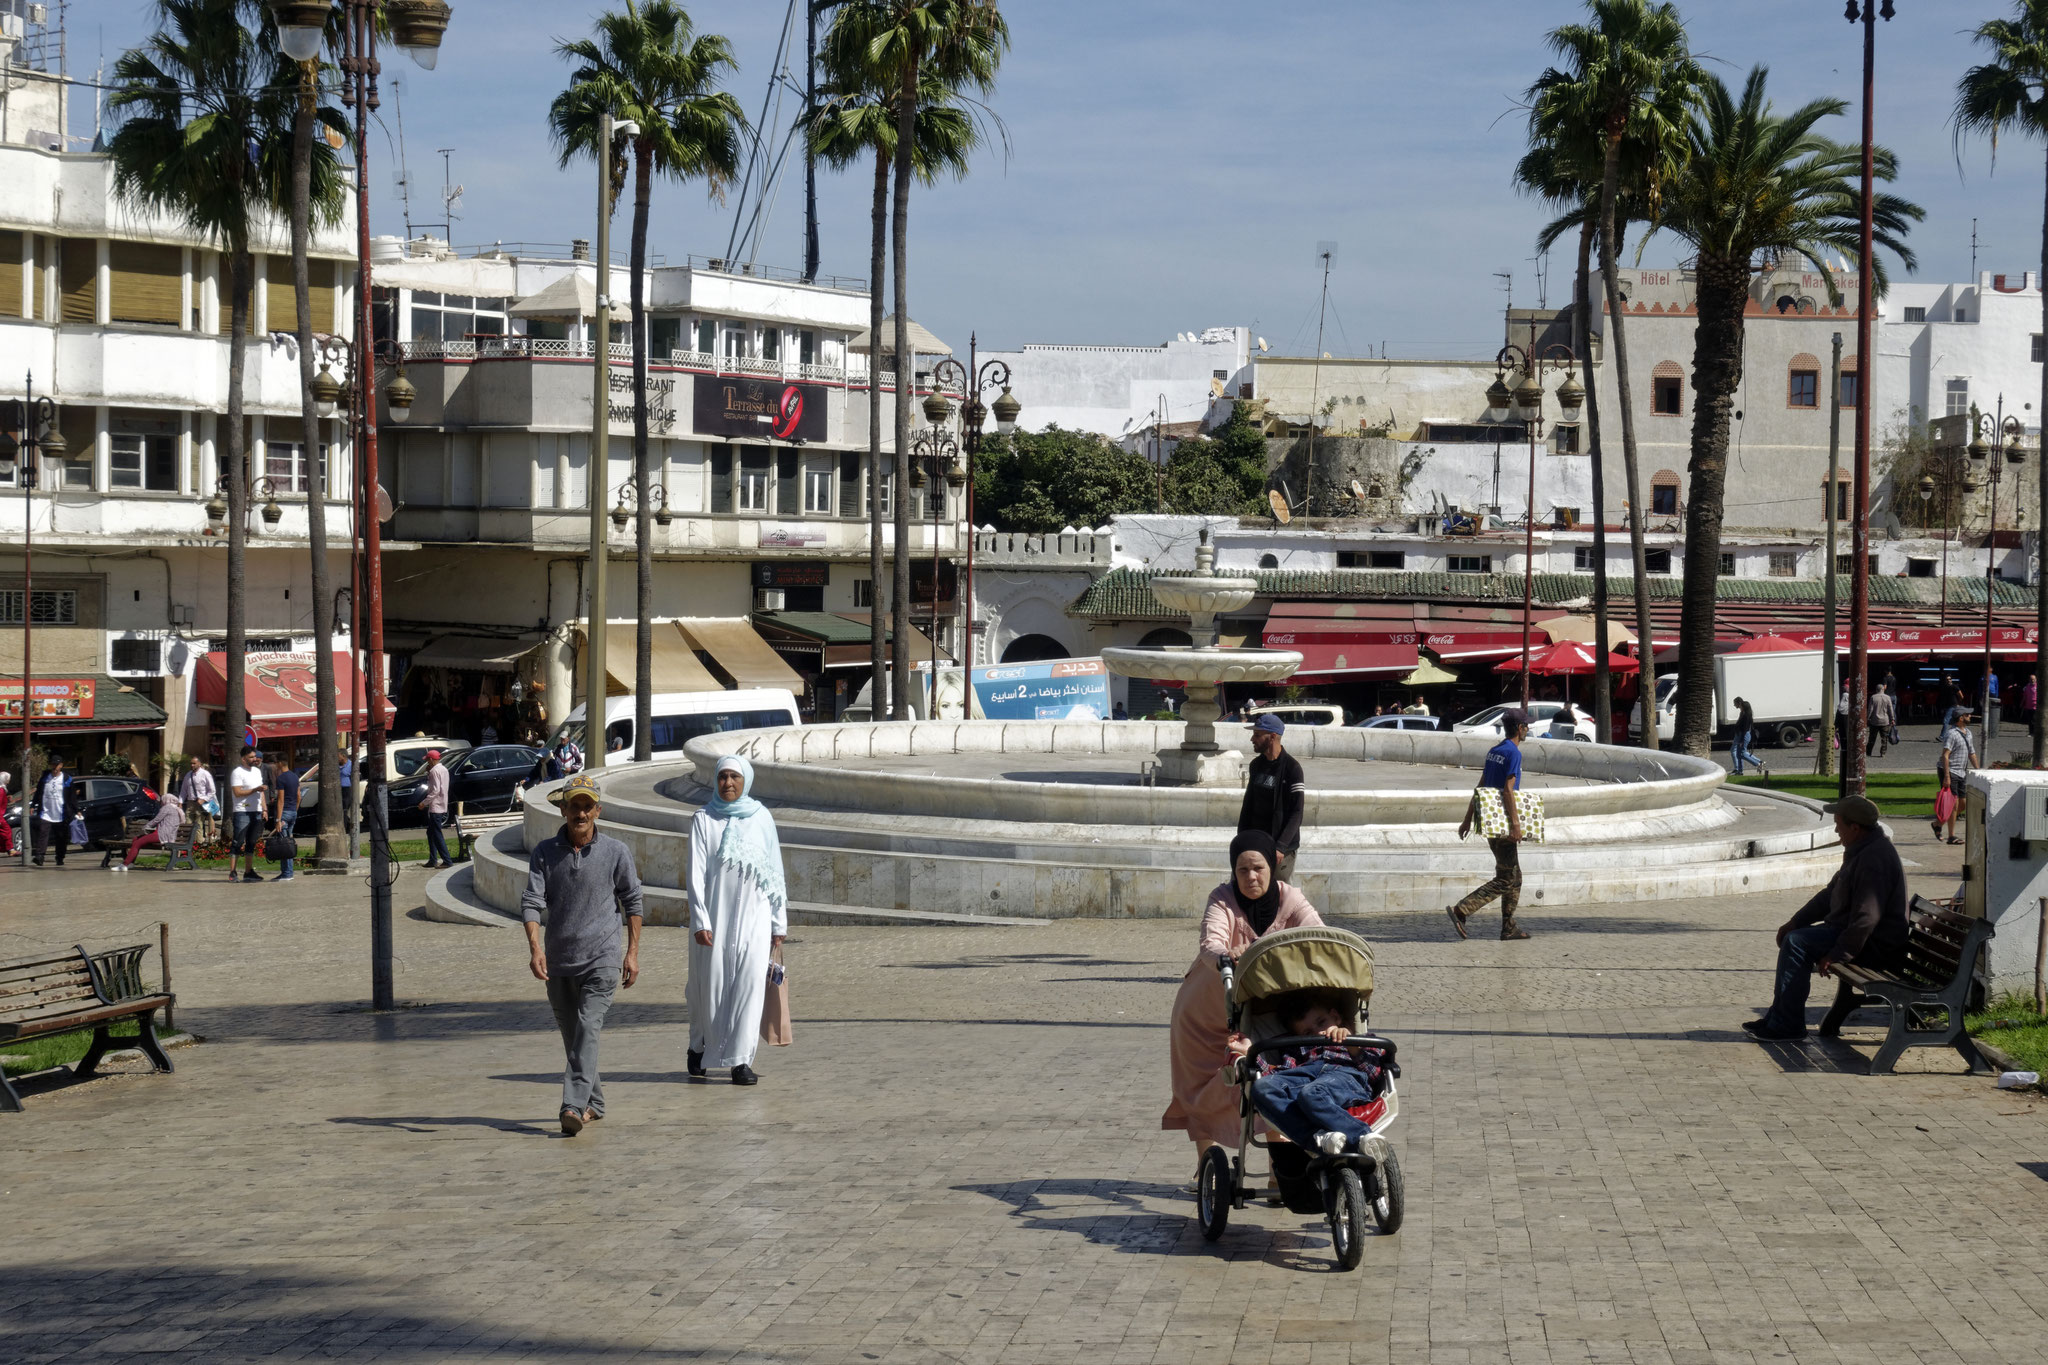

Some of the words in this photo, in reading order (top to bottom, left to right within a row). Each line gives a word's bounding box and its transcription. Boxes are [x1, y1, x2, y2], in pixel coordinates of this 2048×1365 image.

[1641, 272, 1670, 286] Hôtel
[723, 386, 766, 413] Terrasse
[766, 400, 778, 414] du
[773, 386, 803, 438] 9
[256, 651, 288, 661] Vache
[289, 652, 306, 661] qui
[307, 652, 316, 661] ri
[985, 667, 1026, 680] Crest
[1061, 661, 1099, 675] جديد
[991, 689, 1017, 702] أسابيع
[1018, 685, 1027, 698] 2
[1062, 684, 1079, 697] أكثر
